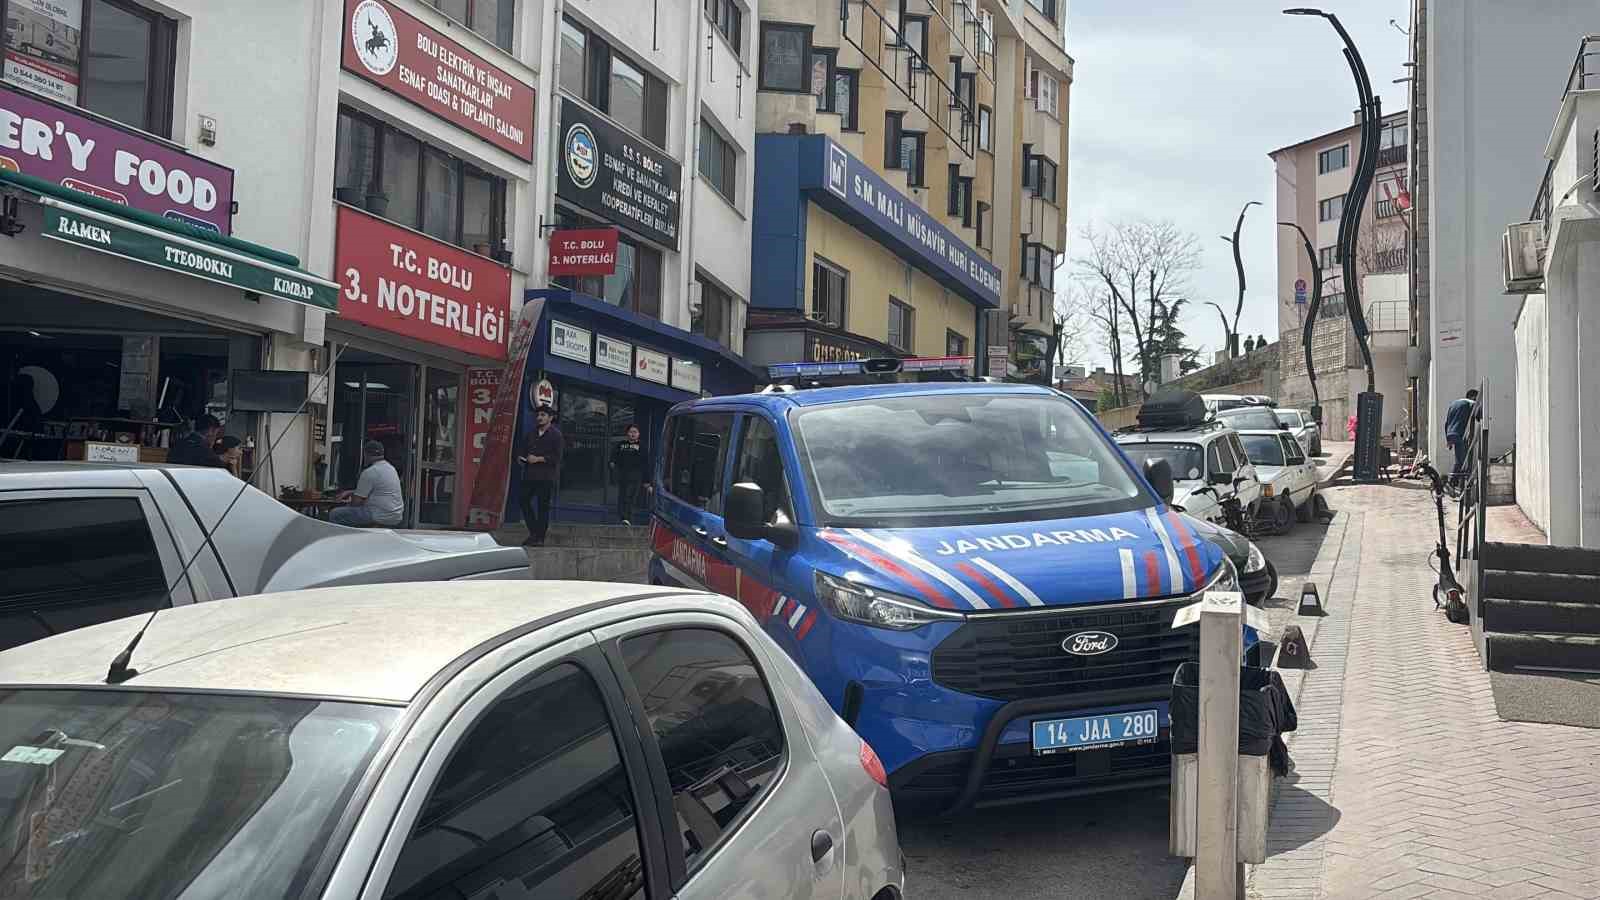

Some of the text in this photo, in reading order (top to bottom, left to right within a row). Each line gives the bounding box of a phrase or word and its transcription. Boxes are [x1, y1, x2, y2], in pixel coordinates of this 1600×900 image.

[418, 32, 512, 101] BOLU ELEKTRİK VE İNŞAAT
[436, 66, 494, 110] SANATKARLARI
[399, 64, 524, 145] ESNAF ODASI & TOPLANTI SALONU
[114, 150, 217, 212] FOOD
[604, 152, 626, 175] ESNAF
[626, 165, 636, 181] VE
[634, 187, 643, 204] VE
[642, 192, 669, 217] KEFALET
[854, 174, 874, 207] S.M.
[878, 193, 904, 227] MALİ
[907, 212, 946, 256] MÜŞAVİR
[58, 216, 112, 245] RAMEN
[562, 240, 605, 250] T.C. BOLU
[164, 246, 233, 279] TTEOBOKKI
[390, 243, 473, 292] T.C. BOLU
[552, 255, 561, 265] 3.
[273, 276, 314, 300] KIMBAP
[344, 267, 504, 344] 3. NOTERLİĞİ
[672, 536, 706, 577] JANDARMA
[936, 526, 1139, 556] JANDARMA
[1072, 633, 1108, 652] Ford
[1048, 713, 1154, 745] 14 JAA 280
